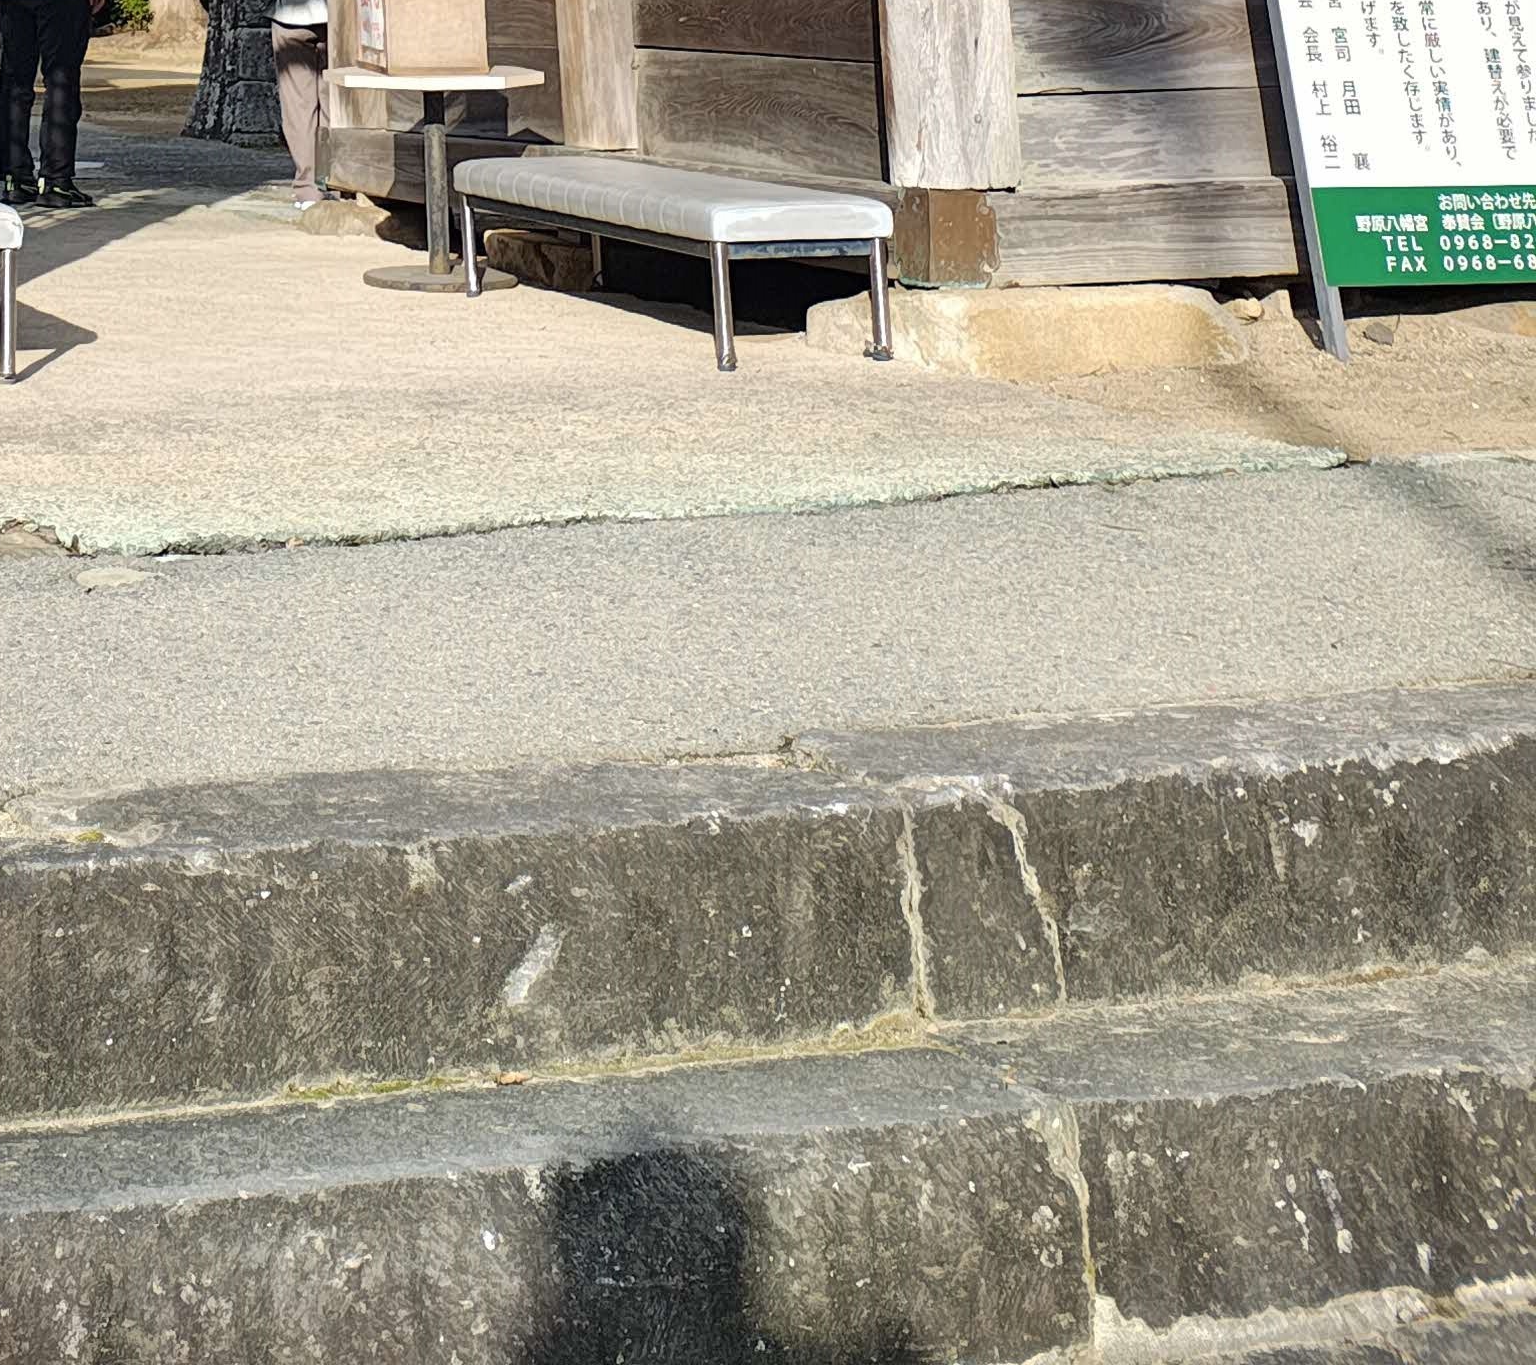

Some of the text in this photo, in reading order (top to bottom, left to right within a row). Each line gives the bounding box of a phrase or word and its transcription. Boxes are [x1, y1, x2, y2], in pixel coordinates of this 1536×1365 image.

[1302, 26, 1322, 62] 会長
[1331, 26, 1351, 62] 宮司
[1341, 80, 1361, 115] 月田
[1312, 80, 1332, 116] 村上
[1321, 134, 1341, 170] 裕二
[1438, 192, 1536, 211] お問い合わせ先
[1355, 214, 1429, 232] 野原八幡宮
[1381, 235, 1423, 252] TEL
[1386, 255, 1427, 273] FAX
